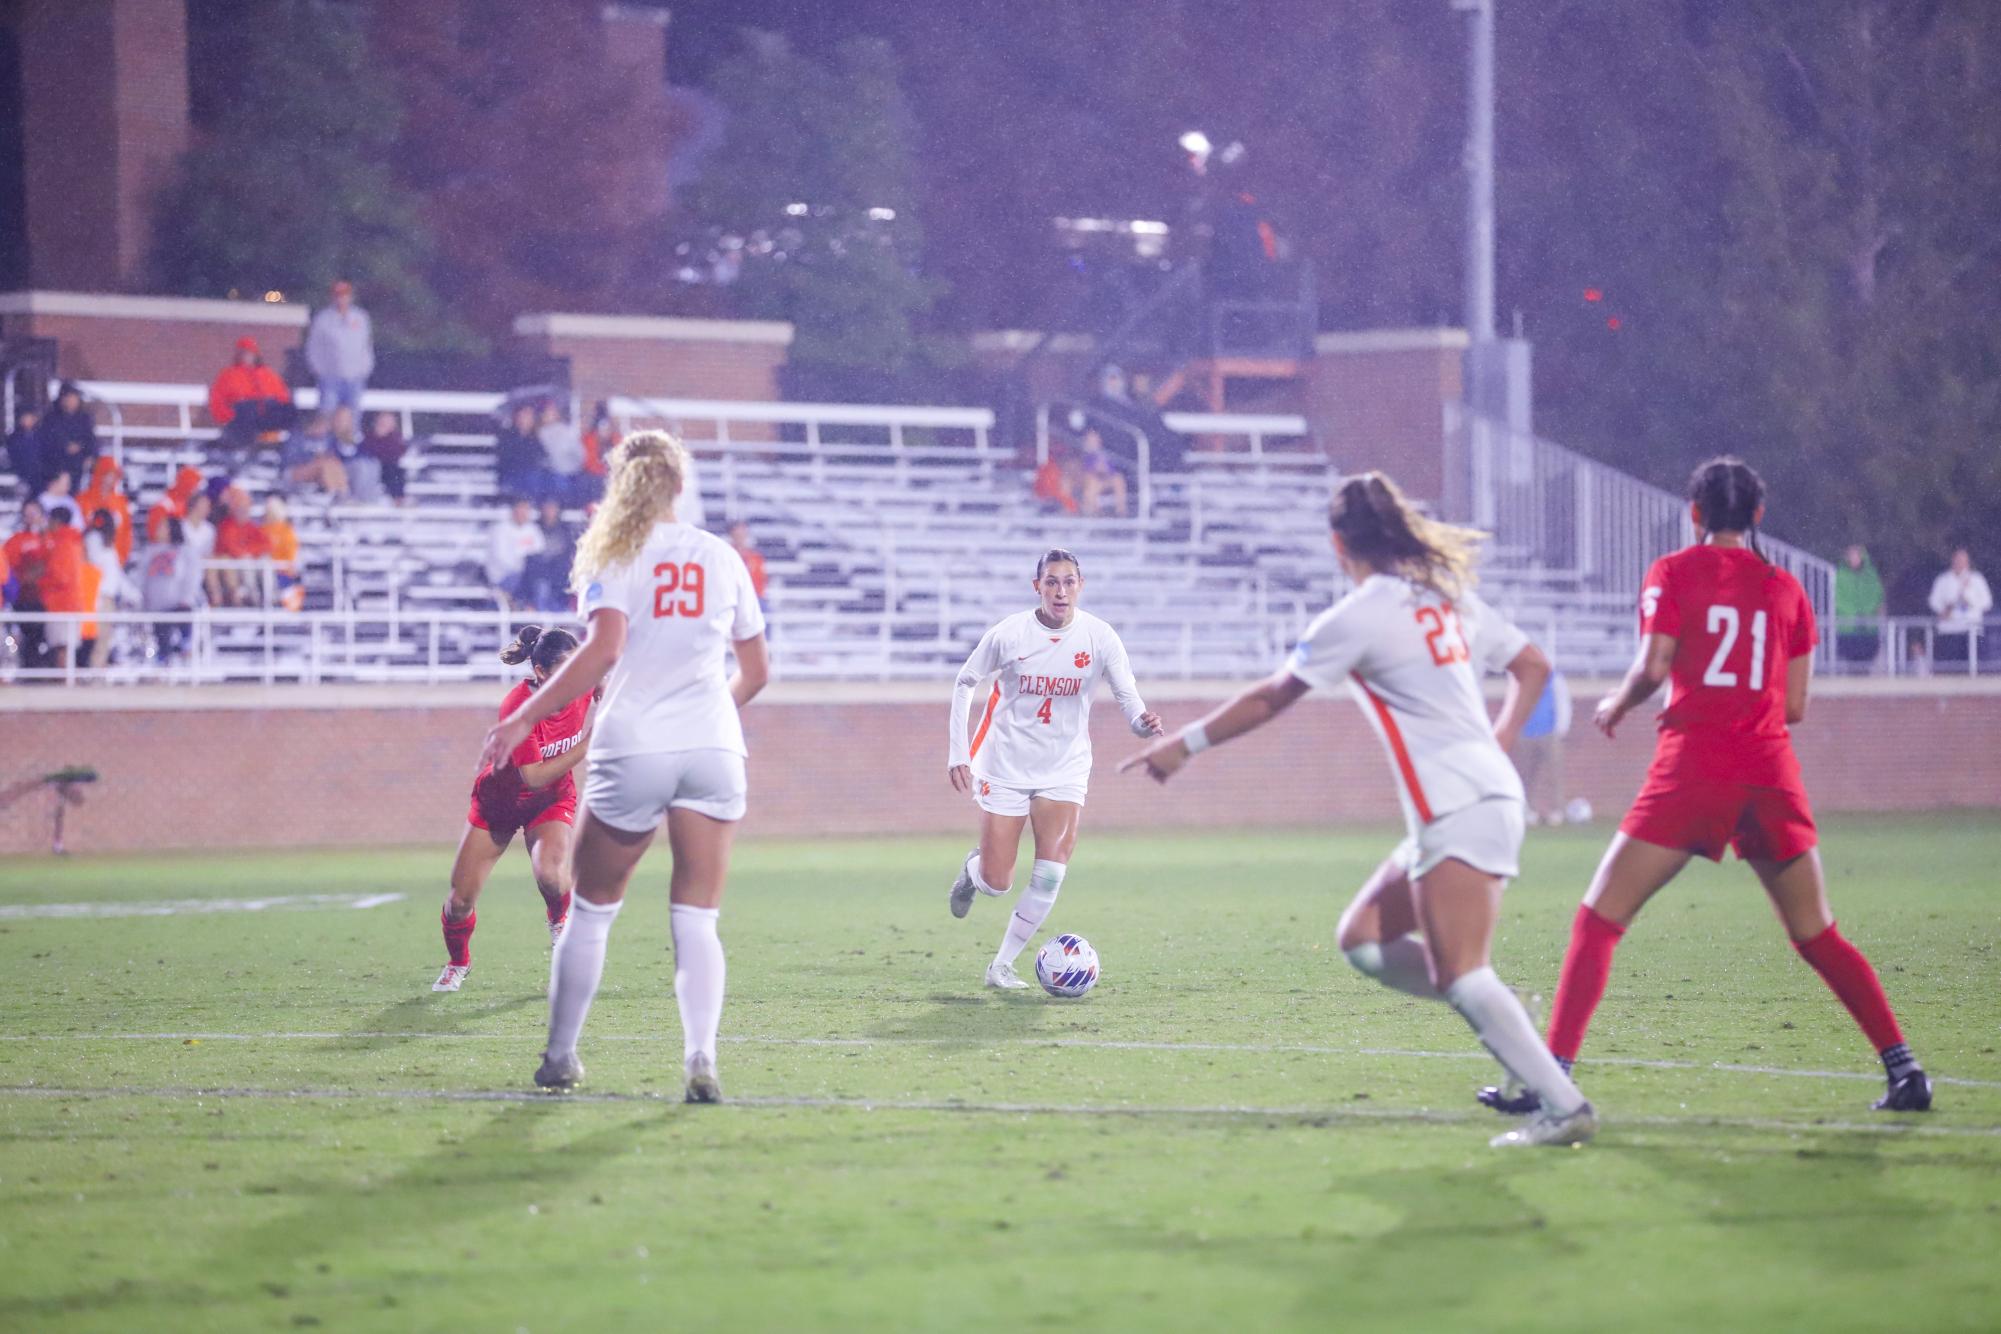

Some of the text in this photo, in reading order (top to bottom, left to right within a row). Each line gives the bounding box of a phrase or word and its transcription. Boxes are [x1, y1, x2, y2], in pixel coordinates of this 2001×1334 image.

[653, 562, 704, 619] 29
[1703, 604, 1767, 691] 21
[1018, 674, 1083, 697] CLEMSON
[1036, 697, 1053, 724] 4
